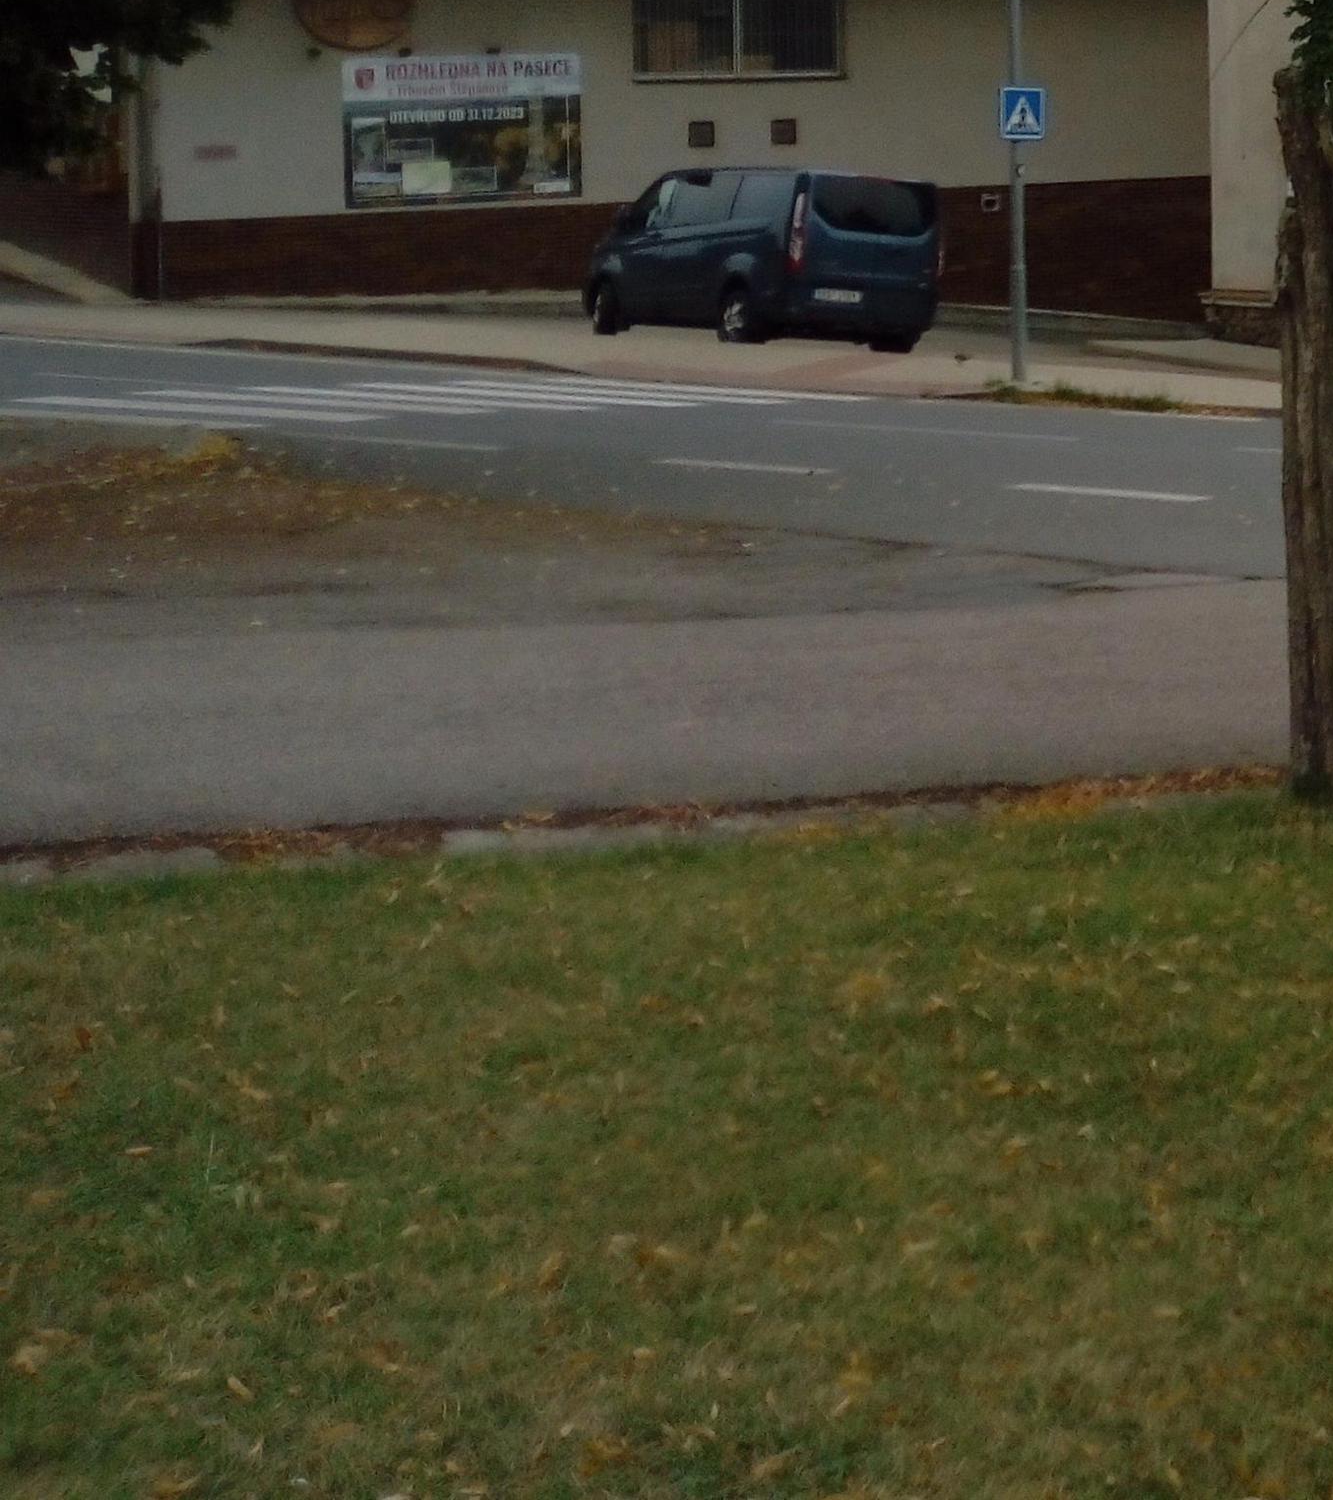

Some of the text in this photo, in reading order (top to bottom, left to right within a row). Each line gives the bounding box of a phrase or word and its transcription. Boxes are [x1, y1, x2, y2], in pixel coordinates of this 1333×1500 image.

[385, 59, 572, 81] ROZHLEDNA NA PASECE
[449, 108, 465, 122] OD
